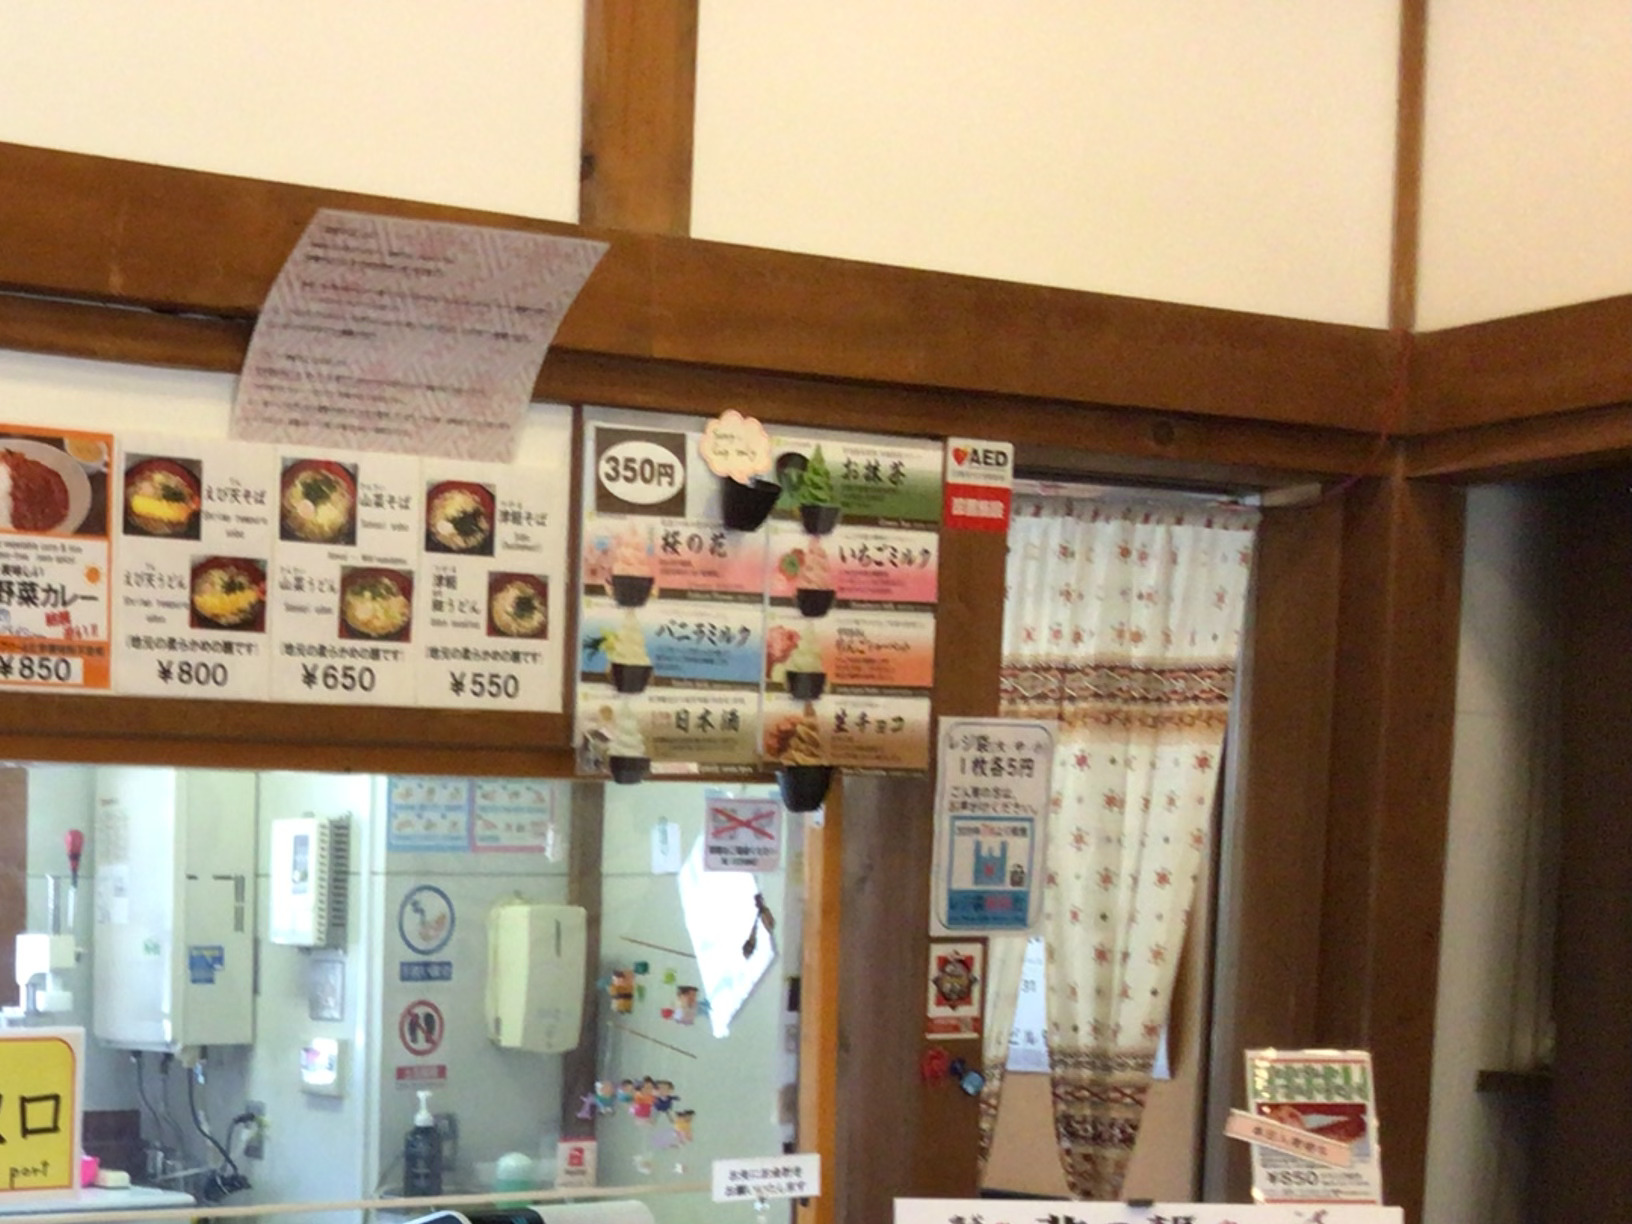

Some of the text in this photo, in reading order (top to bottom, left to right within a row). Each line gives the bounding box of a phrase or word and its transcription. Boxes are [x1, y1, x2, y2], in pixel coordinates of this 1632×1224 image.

[604, 455, 675, 487] 350円
[970, 447, 1009, 467] AED
[156, 659, 228, 687] ¥800
[301, 662, 376, 692] ¥650
[449, 670, 519, 699] ¥550
[675, 707, 740, 733] 日本酒
[10, 1160, 50, 1189] port
